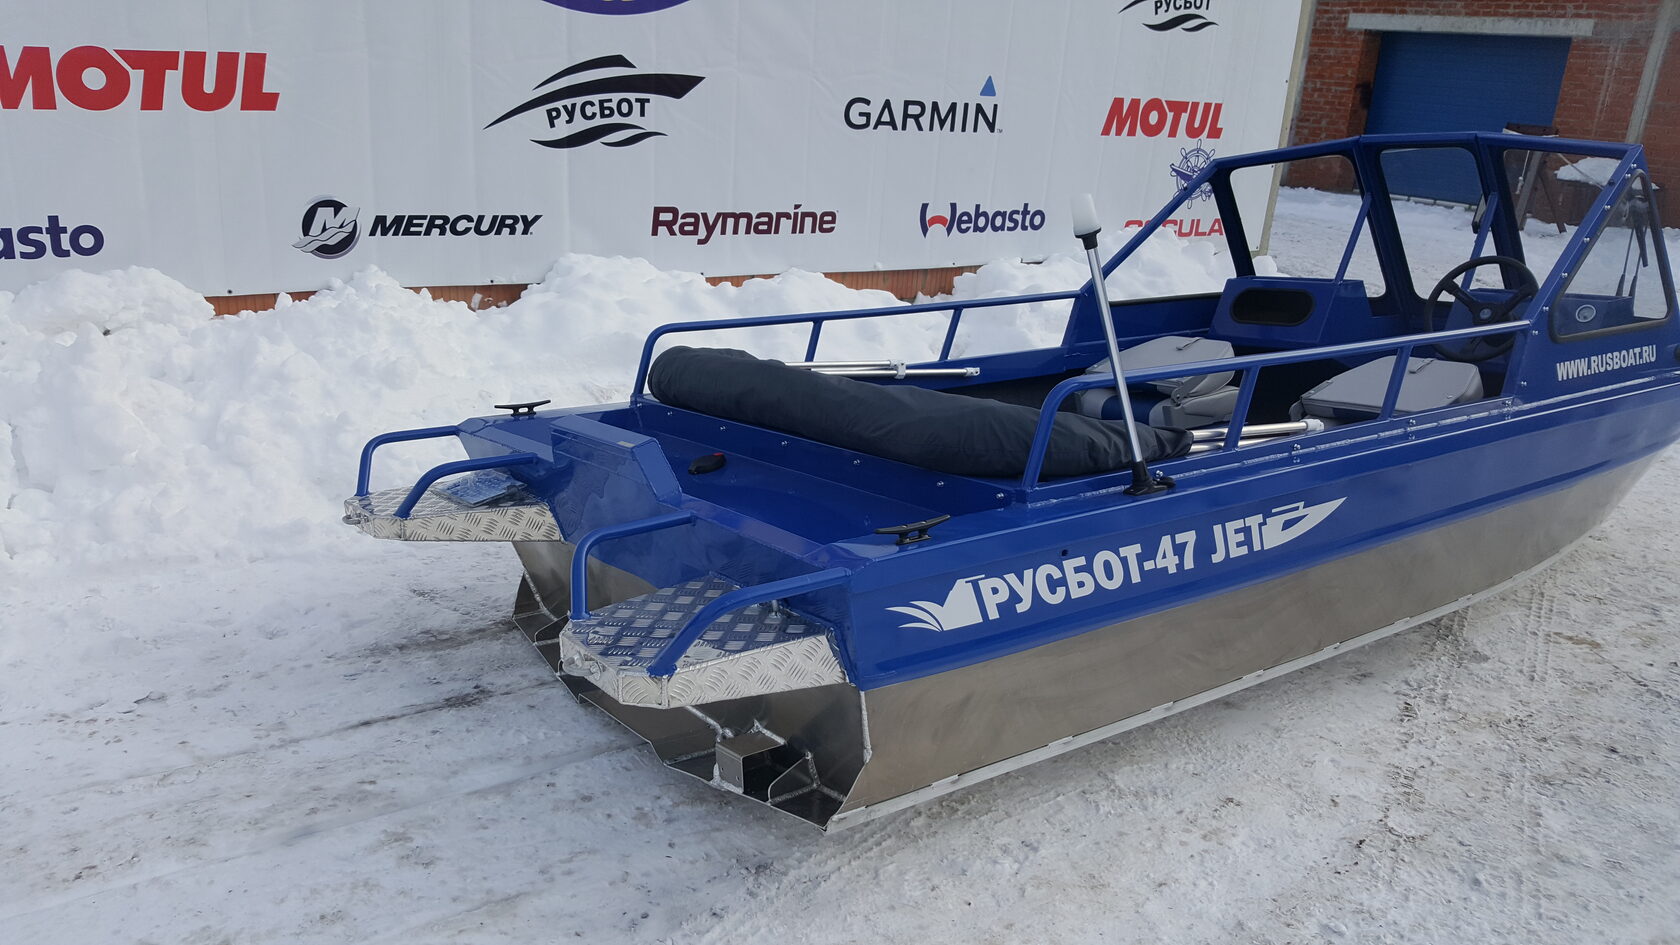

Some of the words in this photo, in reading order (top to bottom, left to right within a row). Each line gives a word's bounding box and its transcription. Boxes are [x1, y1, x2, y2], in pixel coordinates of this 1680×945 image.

[0, 45, 280, 112] MOTUL
[545, 97, 651, 129] РУСБОТ
[843, 97, 998, 134] GARMIN
[1100, 97, 1224, 139] MOTUL
[368, 214, 543, 237] MERCURY
[651, 204, 837, 245] Raymarine
[919, 202, 1046, 238] Webasto
[1556, 344, 1657, 382] WWW.RUSBOAT.RU
[977, 529, 1198, 621] РУСБОТ-47
[1210, 512, 1266, 565] JET
